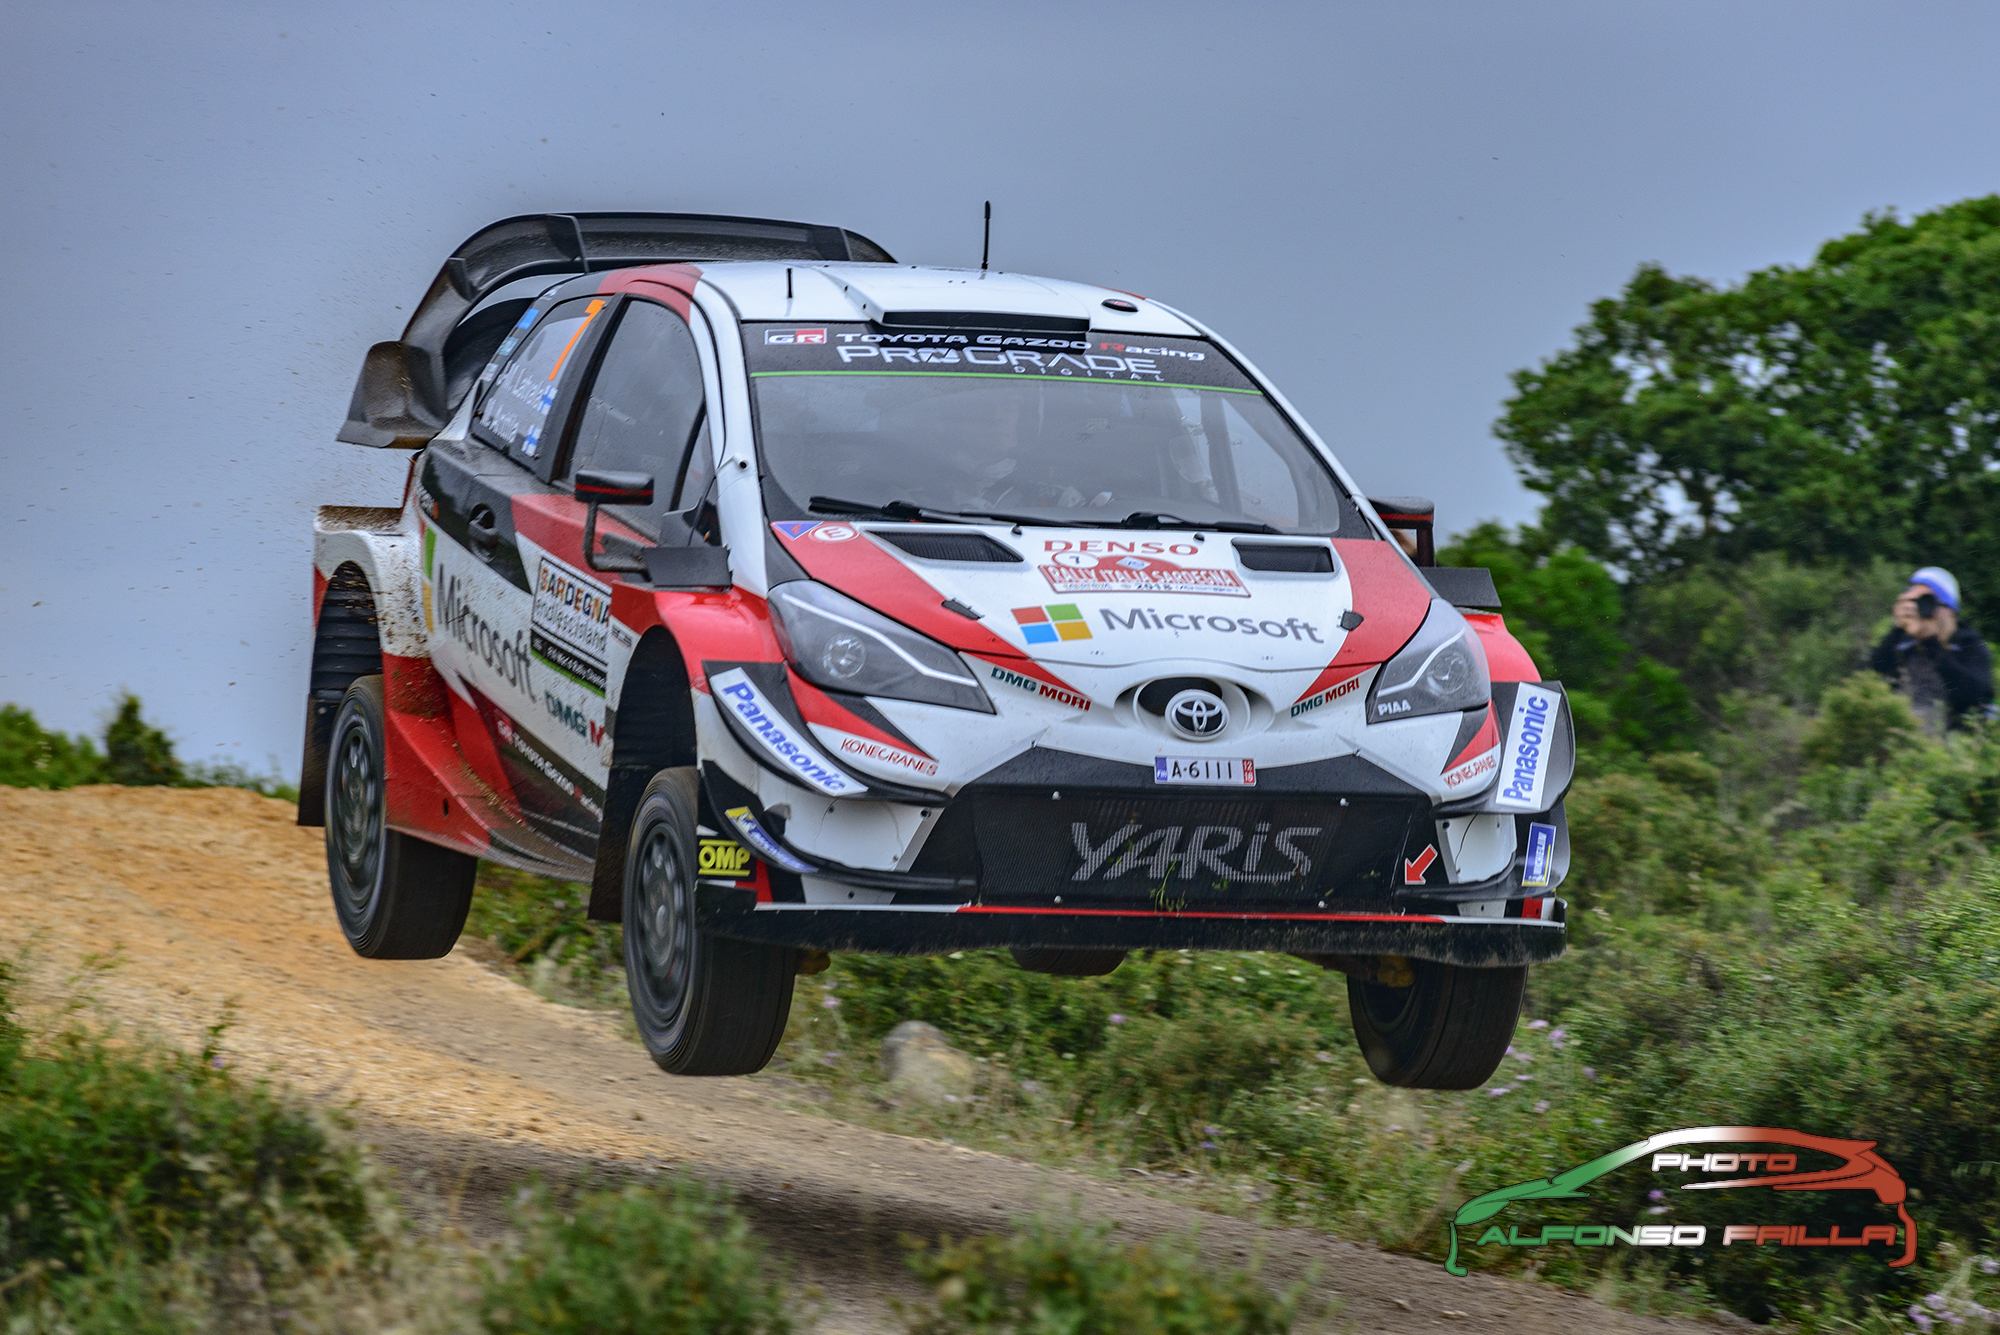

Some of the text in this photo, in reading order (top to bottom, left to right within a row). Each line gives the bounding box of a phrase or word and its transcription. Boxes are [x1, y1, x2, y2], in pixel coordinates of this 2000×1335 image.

[768, 334, 824, 344] GR
[836, 333, 1205, 361] TOYOTA GAZOO Racing
[1014, 366, 1165, 381] DIGITAL
[1044, 540, 1199, 556] DENSO
[1049, 564, 1241, 588] RALLY ITALIA SARDEGNA
[437, 563, 537, 704] Microsoft
[1099, 608, 1324, 644] Microsoft
[991, 665, 1092, 711] DMG MORI
[1290, 677, 1360, 718] DMG MORI
[545, 691, 587, 738] DMG
[1377, 699, 1412, 716] PIAA
[721, 681, 846, 791] Panasonic
[1502, 695, 1549, 803] Panasonic
[840, 737, 939, 777] KONECRANES
[1172, 760, 1232, 779] A-6111
[1443, 754, 1497, 790] KONECRANES
[698, 845, 751, 870] OMP
